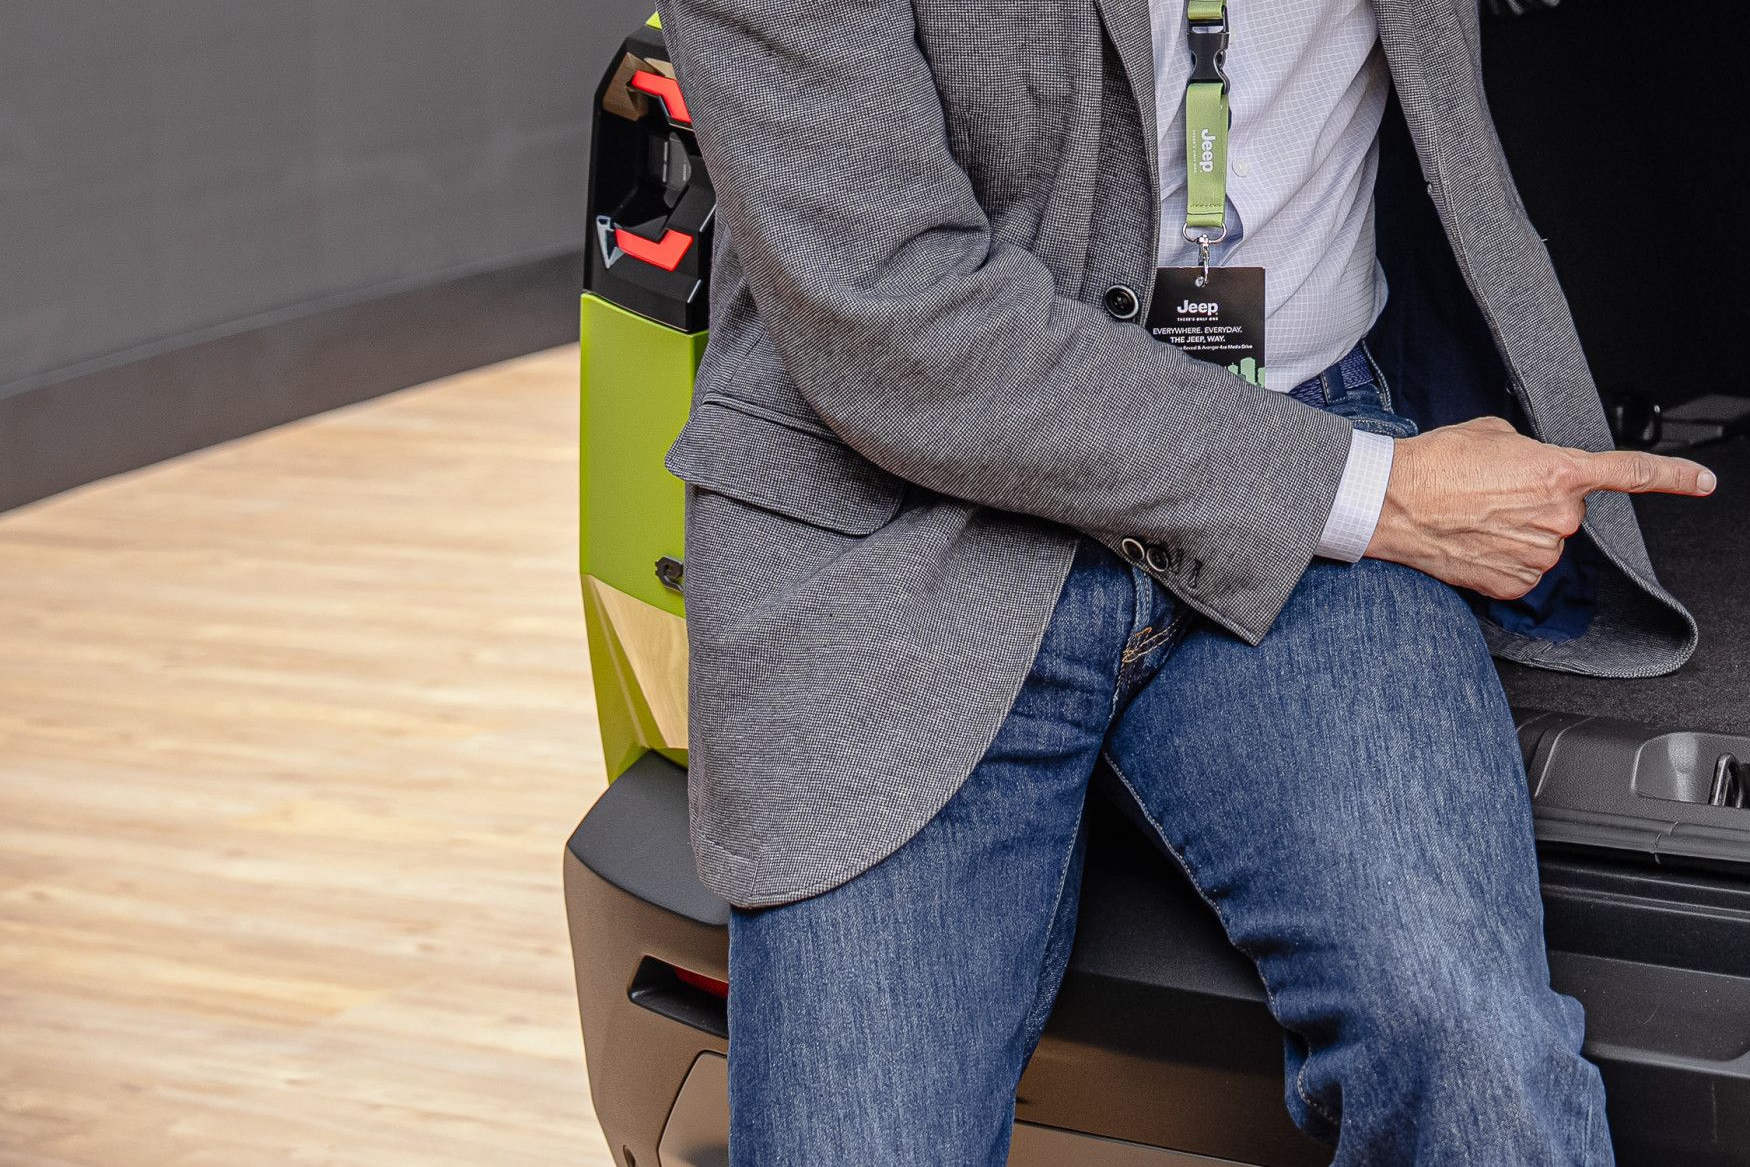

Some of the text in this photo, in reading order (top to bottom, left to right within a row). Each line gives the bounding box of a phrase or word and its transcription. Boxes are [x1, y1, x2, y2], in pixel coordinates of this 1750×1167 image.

[1200, 128, 1216, 173] Jeep
[1177, 299, 1219, 316] Jeep
[1152, 326, 1243, 335] EVERYWHERE. EVERYDAY.
